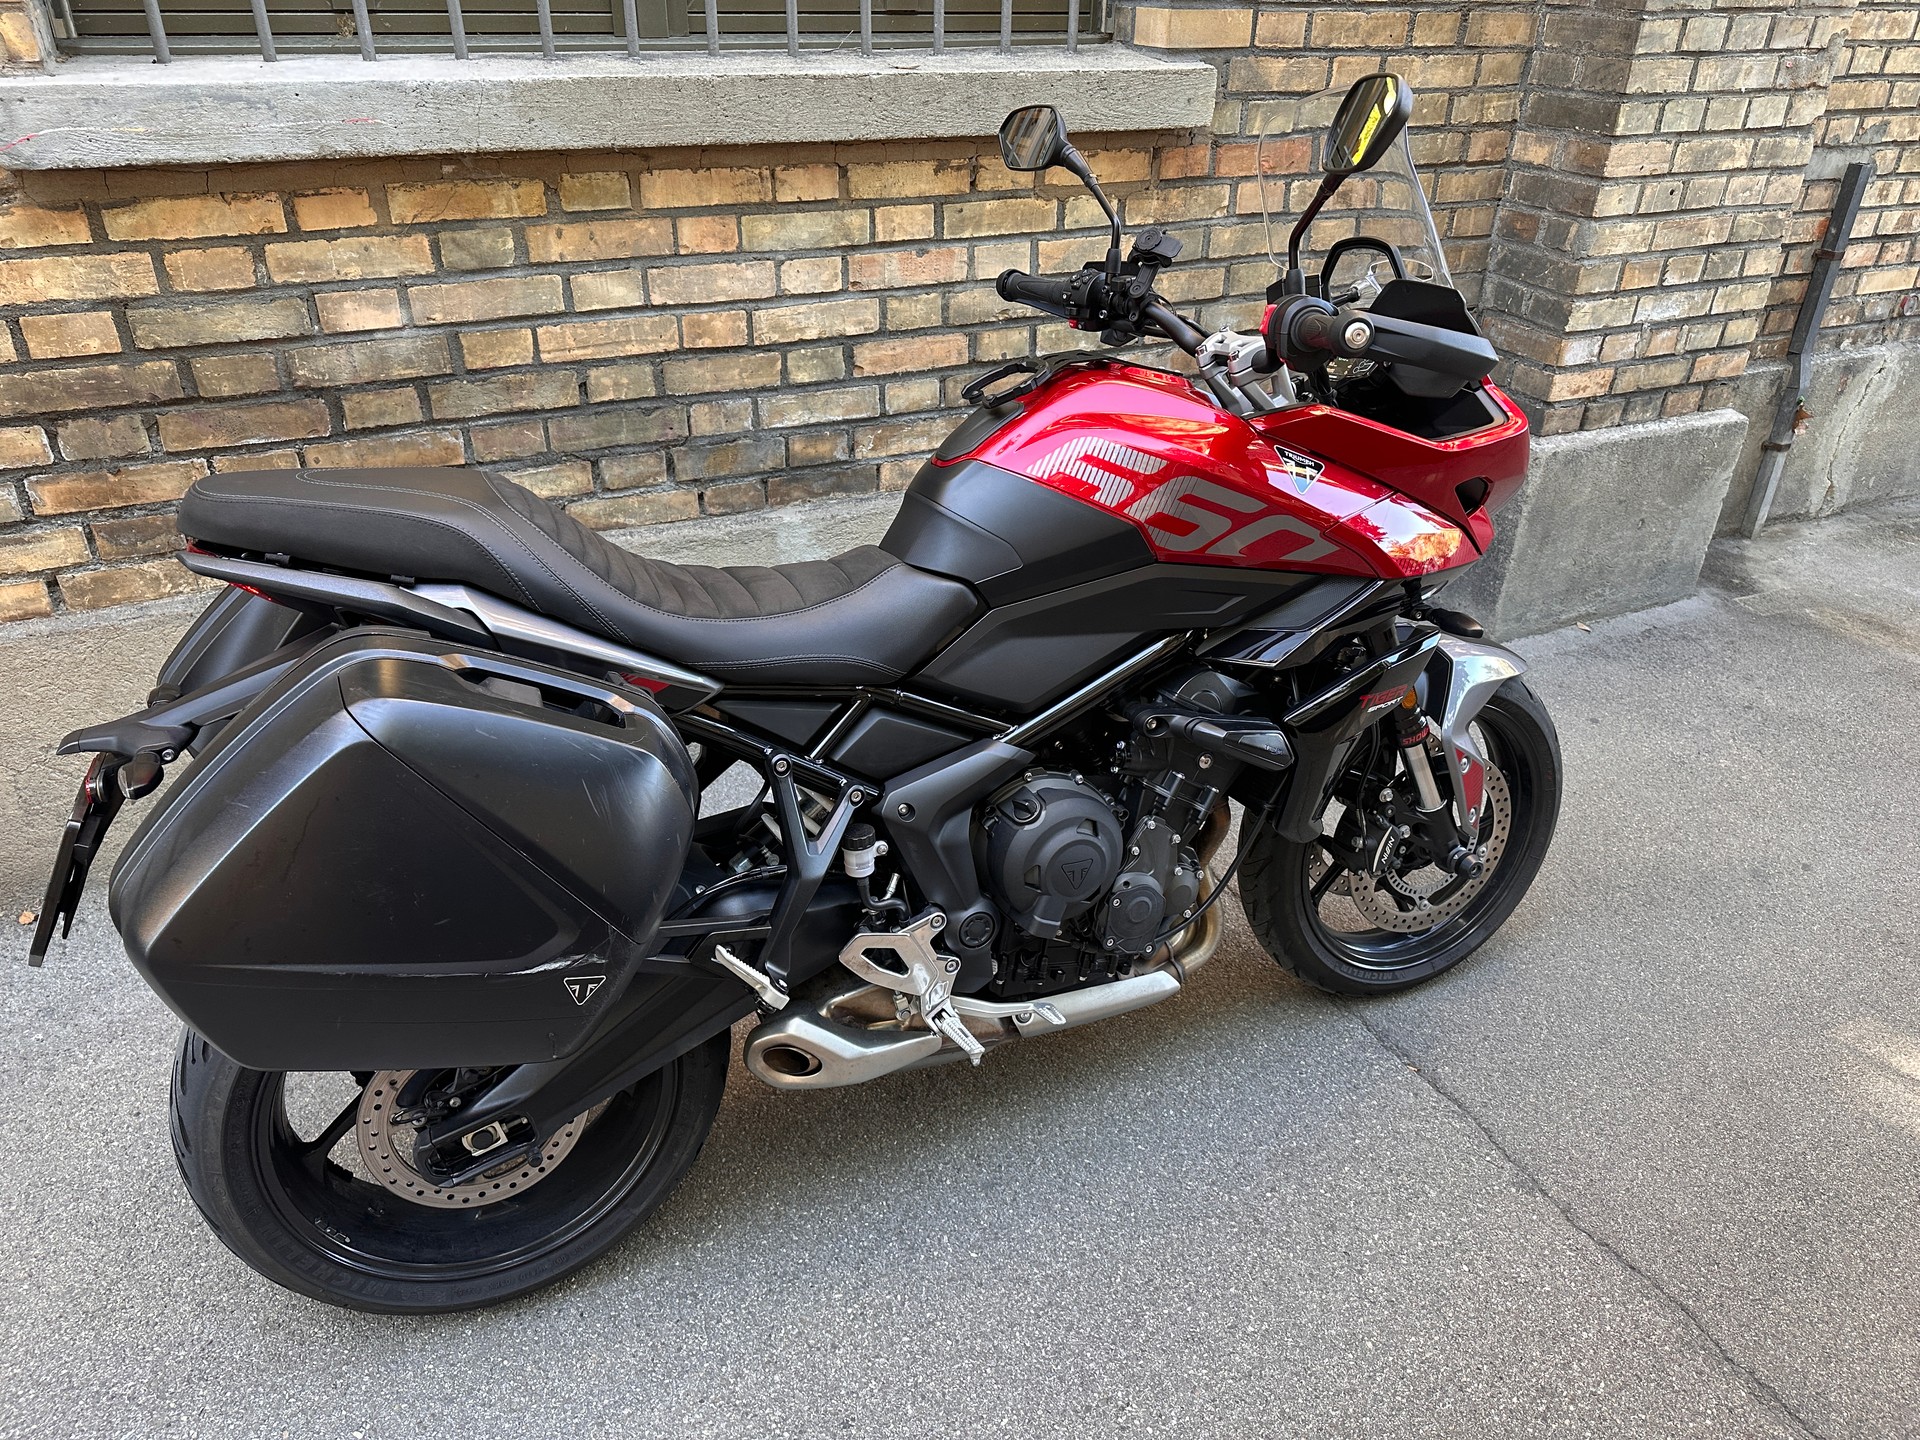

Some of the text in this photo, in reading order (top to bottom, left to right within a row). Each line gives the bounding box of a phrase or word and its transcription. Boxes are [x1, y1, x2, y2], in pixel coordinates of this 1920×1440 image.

[1284, 450, 1315, 467] TRIUMPH
[1026, 436, 1340, 561] 660
[1360, 684, 1408, 709] TIGER
[1367, 696, 1404, 713] SPORT
[1402, 727, 1429, 745] SHOW
[1340, 964, 1394, 981] MICHELIN
[258, 1221, 391, 1298] MICHELIN
